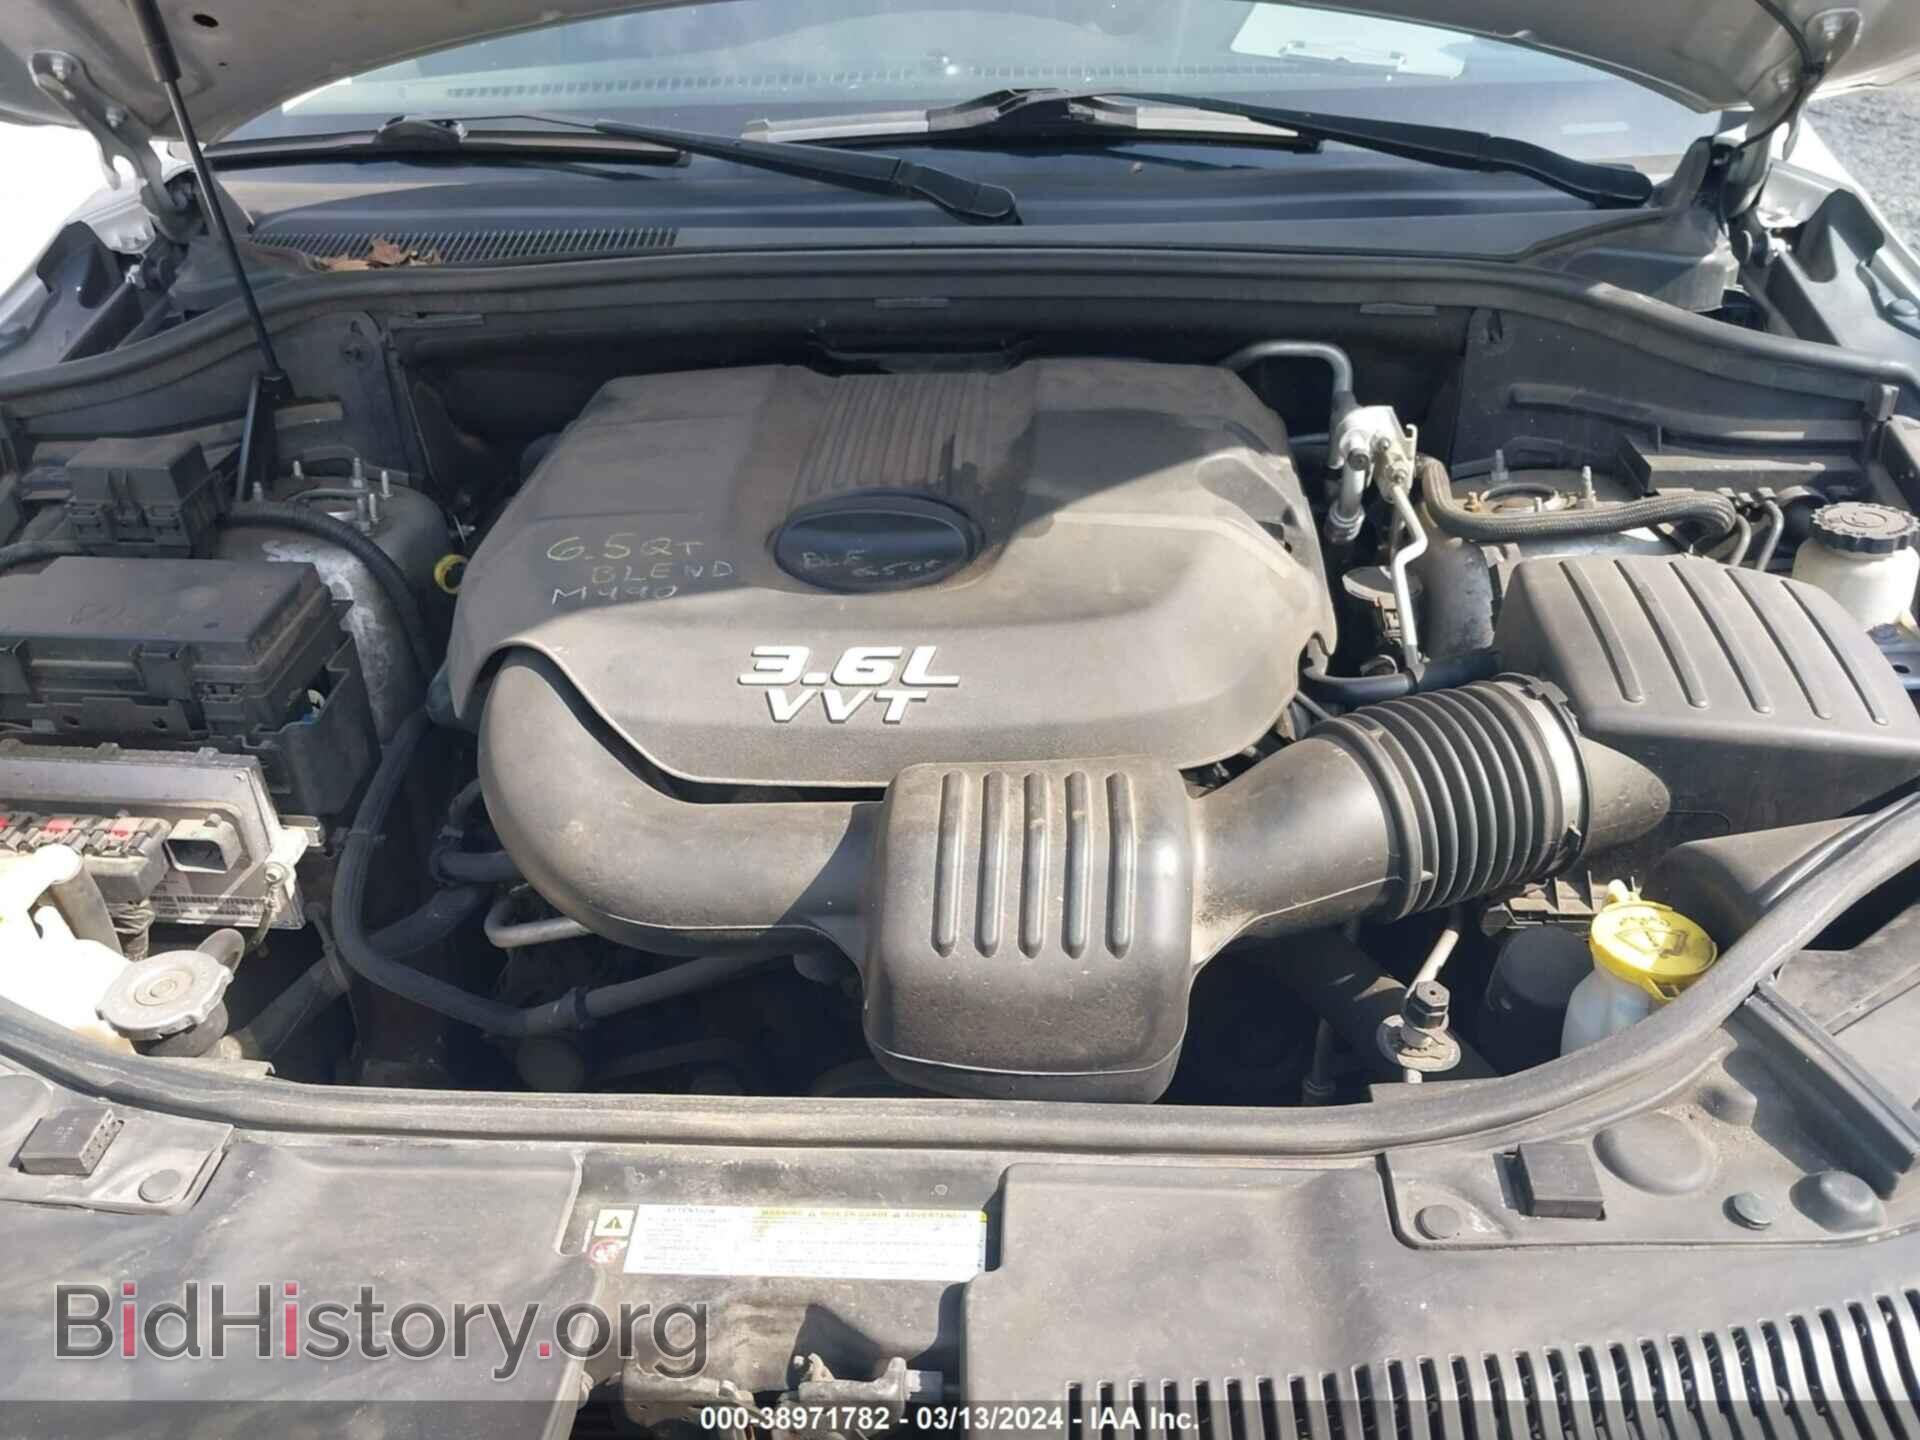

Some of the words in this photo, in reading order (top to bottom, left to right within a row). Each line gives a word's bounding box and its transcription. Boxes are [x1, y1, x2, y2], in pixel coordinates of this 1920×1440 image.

[591, 560, 735, 584] BLEND
[737, 645, 961, 687] 3.6L
[765, 688, 929, 724] VVT
